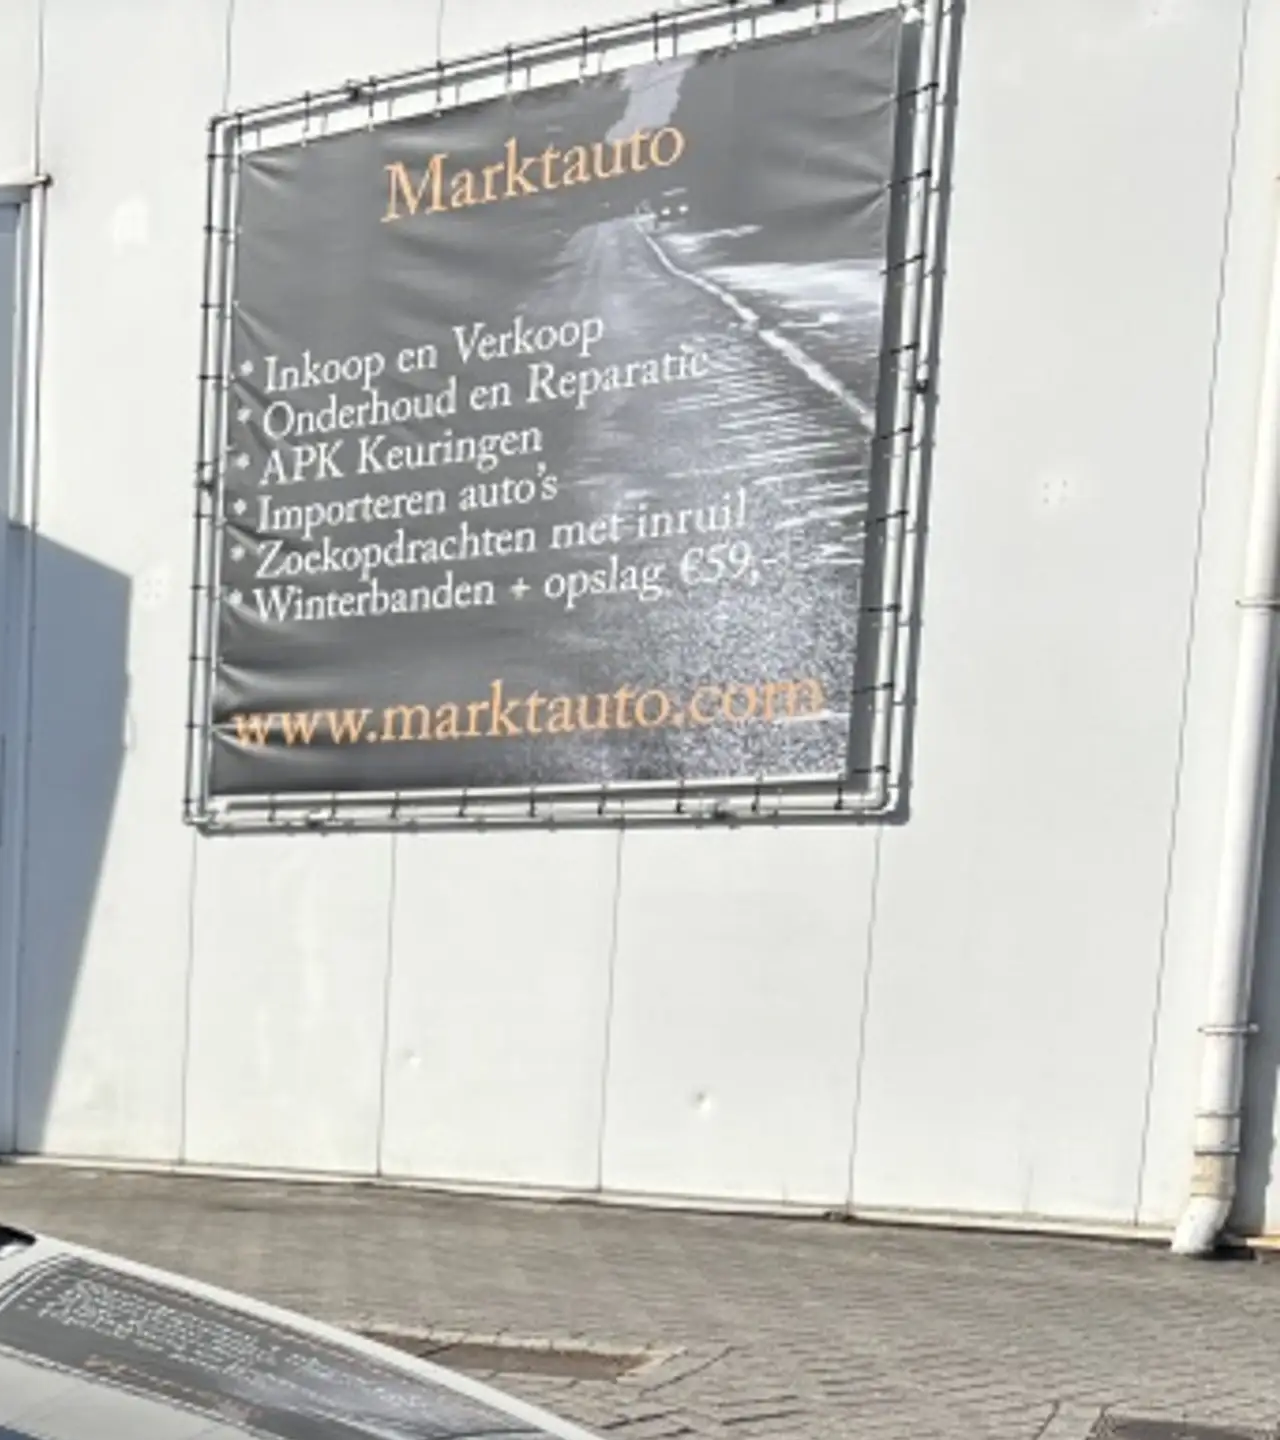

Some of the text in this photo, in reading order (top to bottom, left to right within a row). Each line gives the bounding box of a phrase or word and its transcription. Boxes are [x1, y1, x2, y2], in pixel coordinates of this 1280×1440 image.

[381, 126, 686, 223] Marktauto
[263, 315, 604, 394] Inkoop en Verkoop
[263, 344, 710, 439] Onderhoud en Reparatie
[257, 427, 542, 488] APK Keuringen
[255, 486, 747, 582] Zoekopdrachten met inruil
[256, 461, 558, 541] Importeren auto's
[252, 570, 497, 623] Winterbanden
[510, 576, 532, 600] +
[544, 554, 668, 611] opslag
[233, 679, 828, 748] www.marktauto.com
